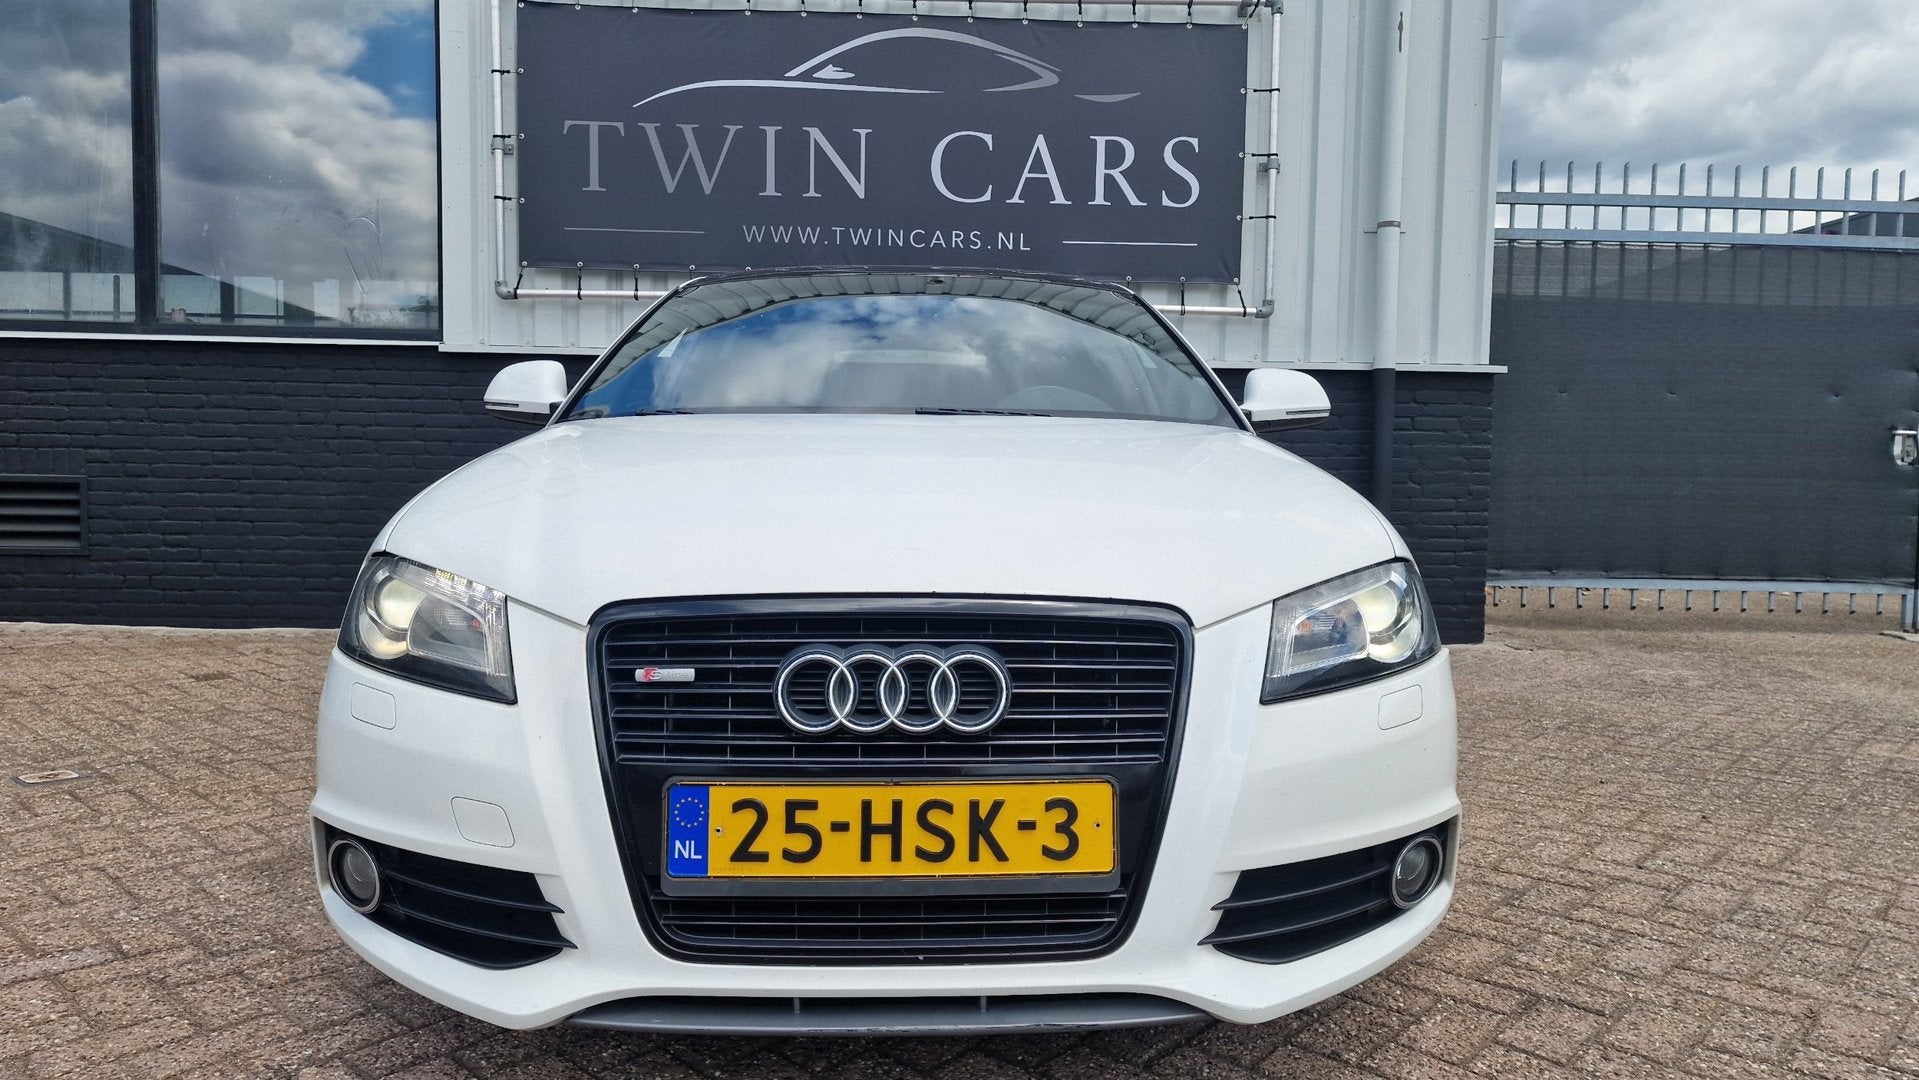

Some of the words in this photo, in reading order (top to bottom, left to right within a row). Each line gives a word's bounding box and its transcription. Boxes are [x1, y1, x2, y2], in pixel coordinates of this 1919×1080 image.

[563, 119, 873, 200] TWIN
[930, 130, 1200, 207] CARS
[742, 224, 1031, 252] WWW.TWINCARS.NL
[674, 839, 702, 859] NL
[729, 798, 1080, 863] 25-HSK-3
